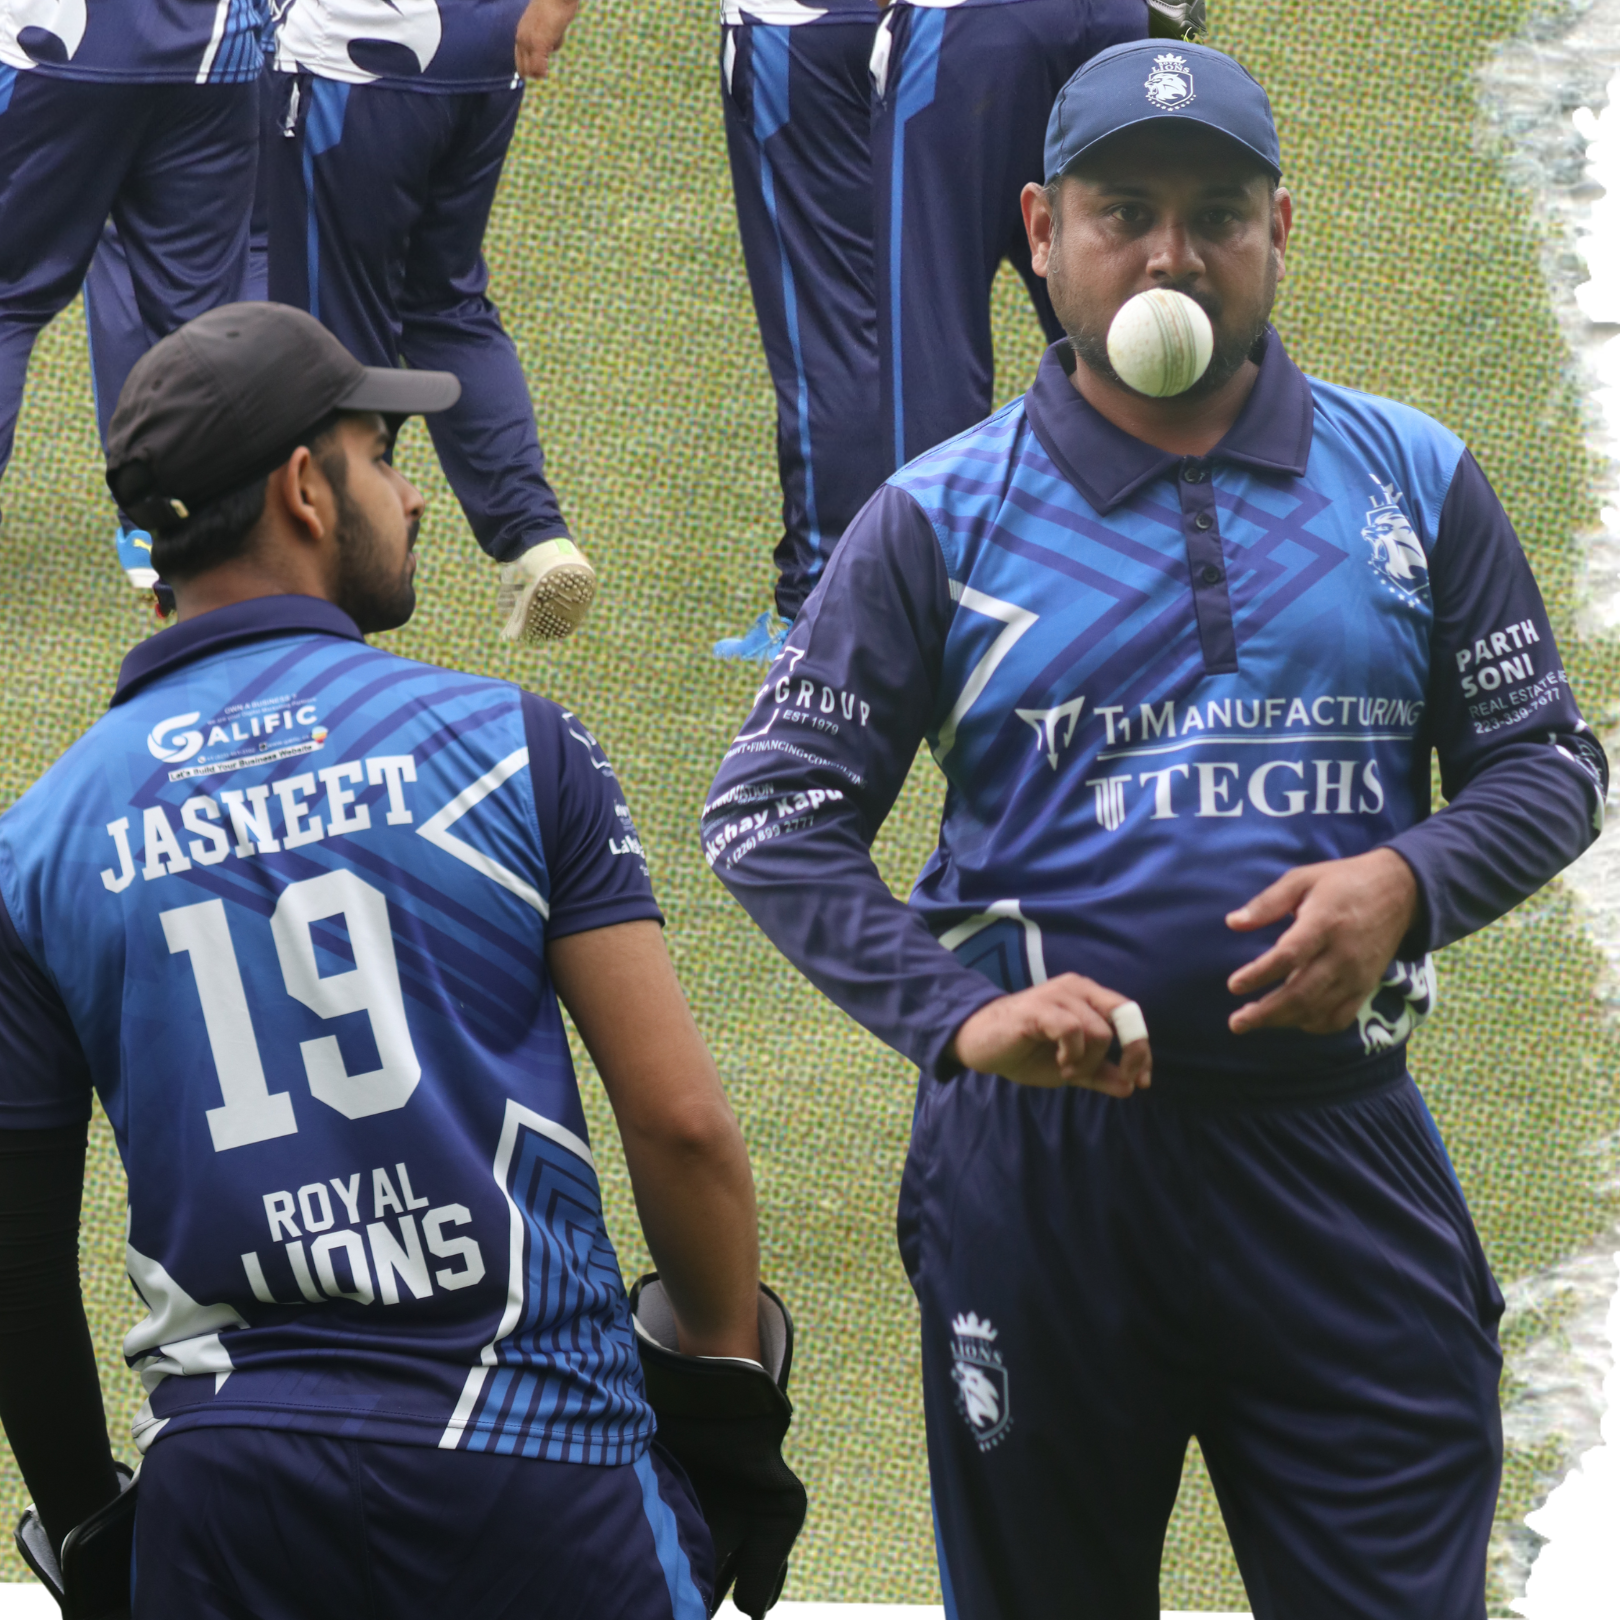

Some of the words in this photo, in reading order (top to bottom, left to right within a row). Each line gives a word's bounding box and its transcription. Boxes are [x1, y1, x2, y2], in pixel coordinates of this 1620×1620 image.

[1151, 63, 1190, 74] LIONS
[1455, 618, 1541, 673] PARTH
[1461, 652, 1535, 699] SONI
[1468, 697, 1509, 720] REAL
[1509, 672, 1558, 706] ESTATE
[147, 705, 318, 763] GALIFIC
[224, 705, 244, 715] OWN
[782, 709, 810, 725] EST
[811, 716, 840, 736] 1979
[1138, 695, 1425, 741] MANUFACTURING
[170, 770, 191, 781] Let's
[193, 765, 216, 776] Build
[218, 761, 237, 772] Your
[239, 753, 277, 768] Business
[278, 744, 313, 758] Website
[1138, 758, 1384, 820] TEGHS
[100, 754, 418, 894] JASNEET
[705, 809, 769, 867] akshay
[732, 836, 758, 864] (226)
[757, 824, 781, 843] 899
[783, 814, 816, 834] 2777
[158, 868, 422, 1153] 19
[262, 1162, 429, 1243] ROYAL
[241, 1202, 486, 1307] LIONS
